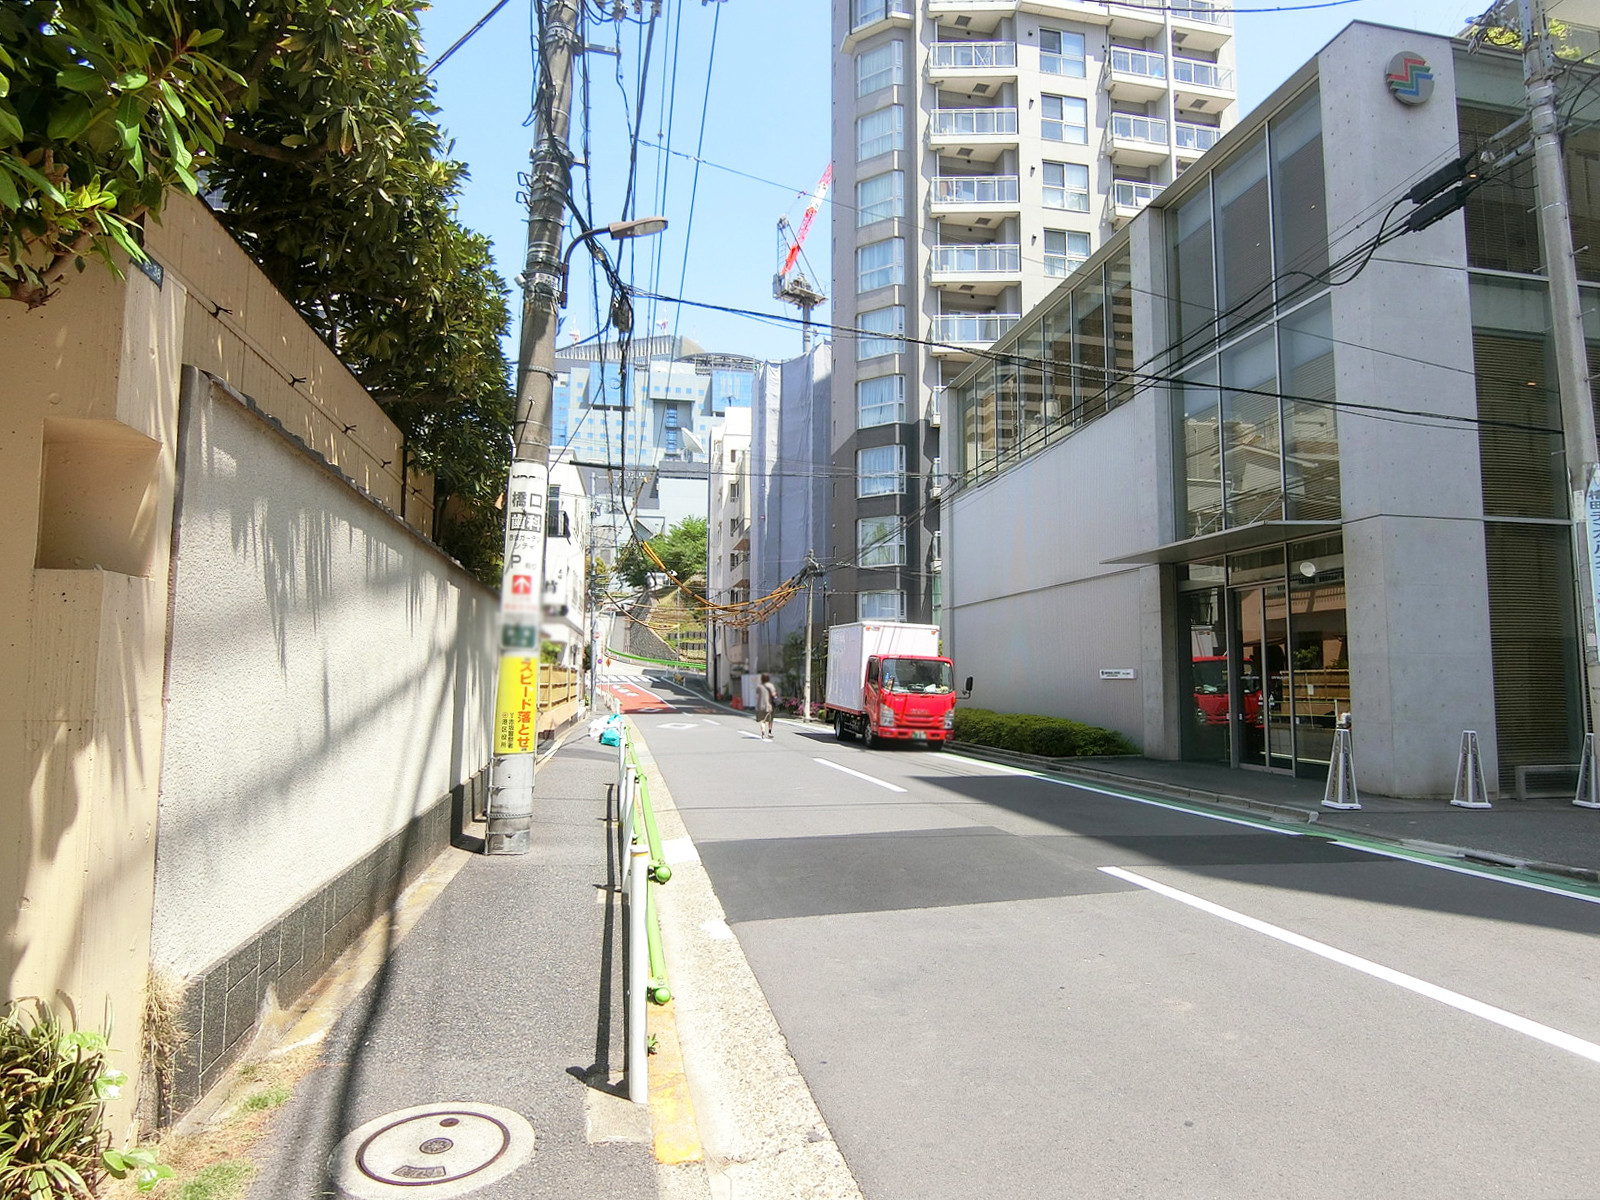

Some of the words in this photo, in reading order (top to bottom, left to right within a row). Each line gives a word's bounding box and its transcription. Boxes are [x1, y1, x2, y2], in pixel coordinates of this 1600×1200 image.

[512, 491, 542, 508] 橋口
[510, 512, 541, 533] 歯科
[517, 661, 533, 748] スピード落とせ
